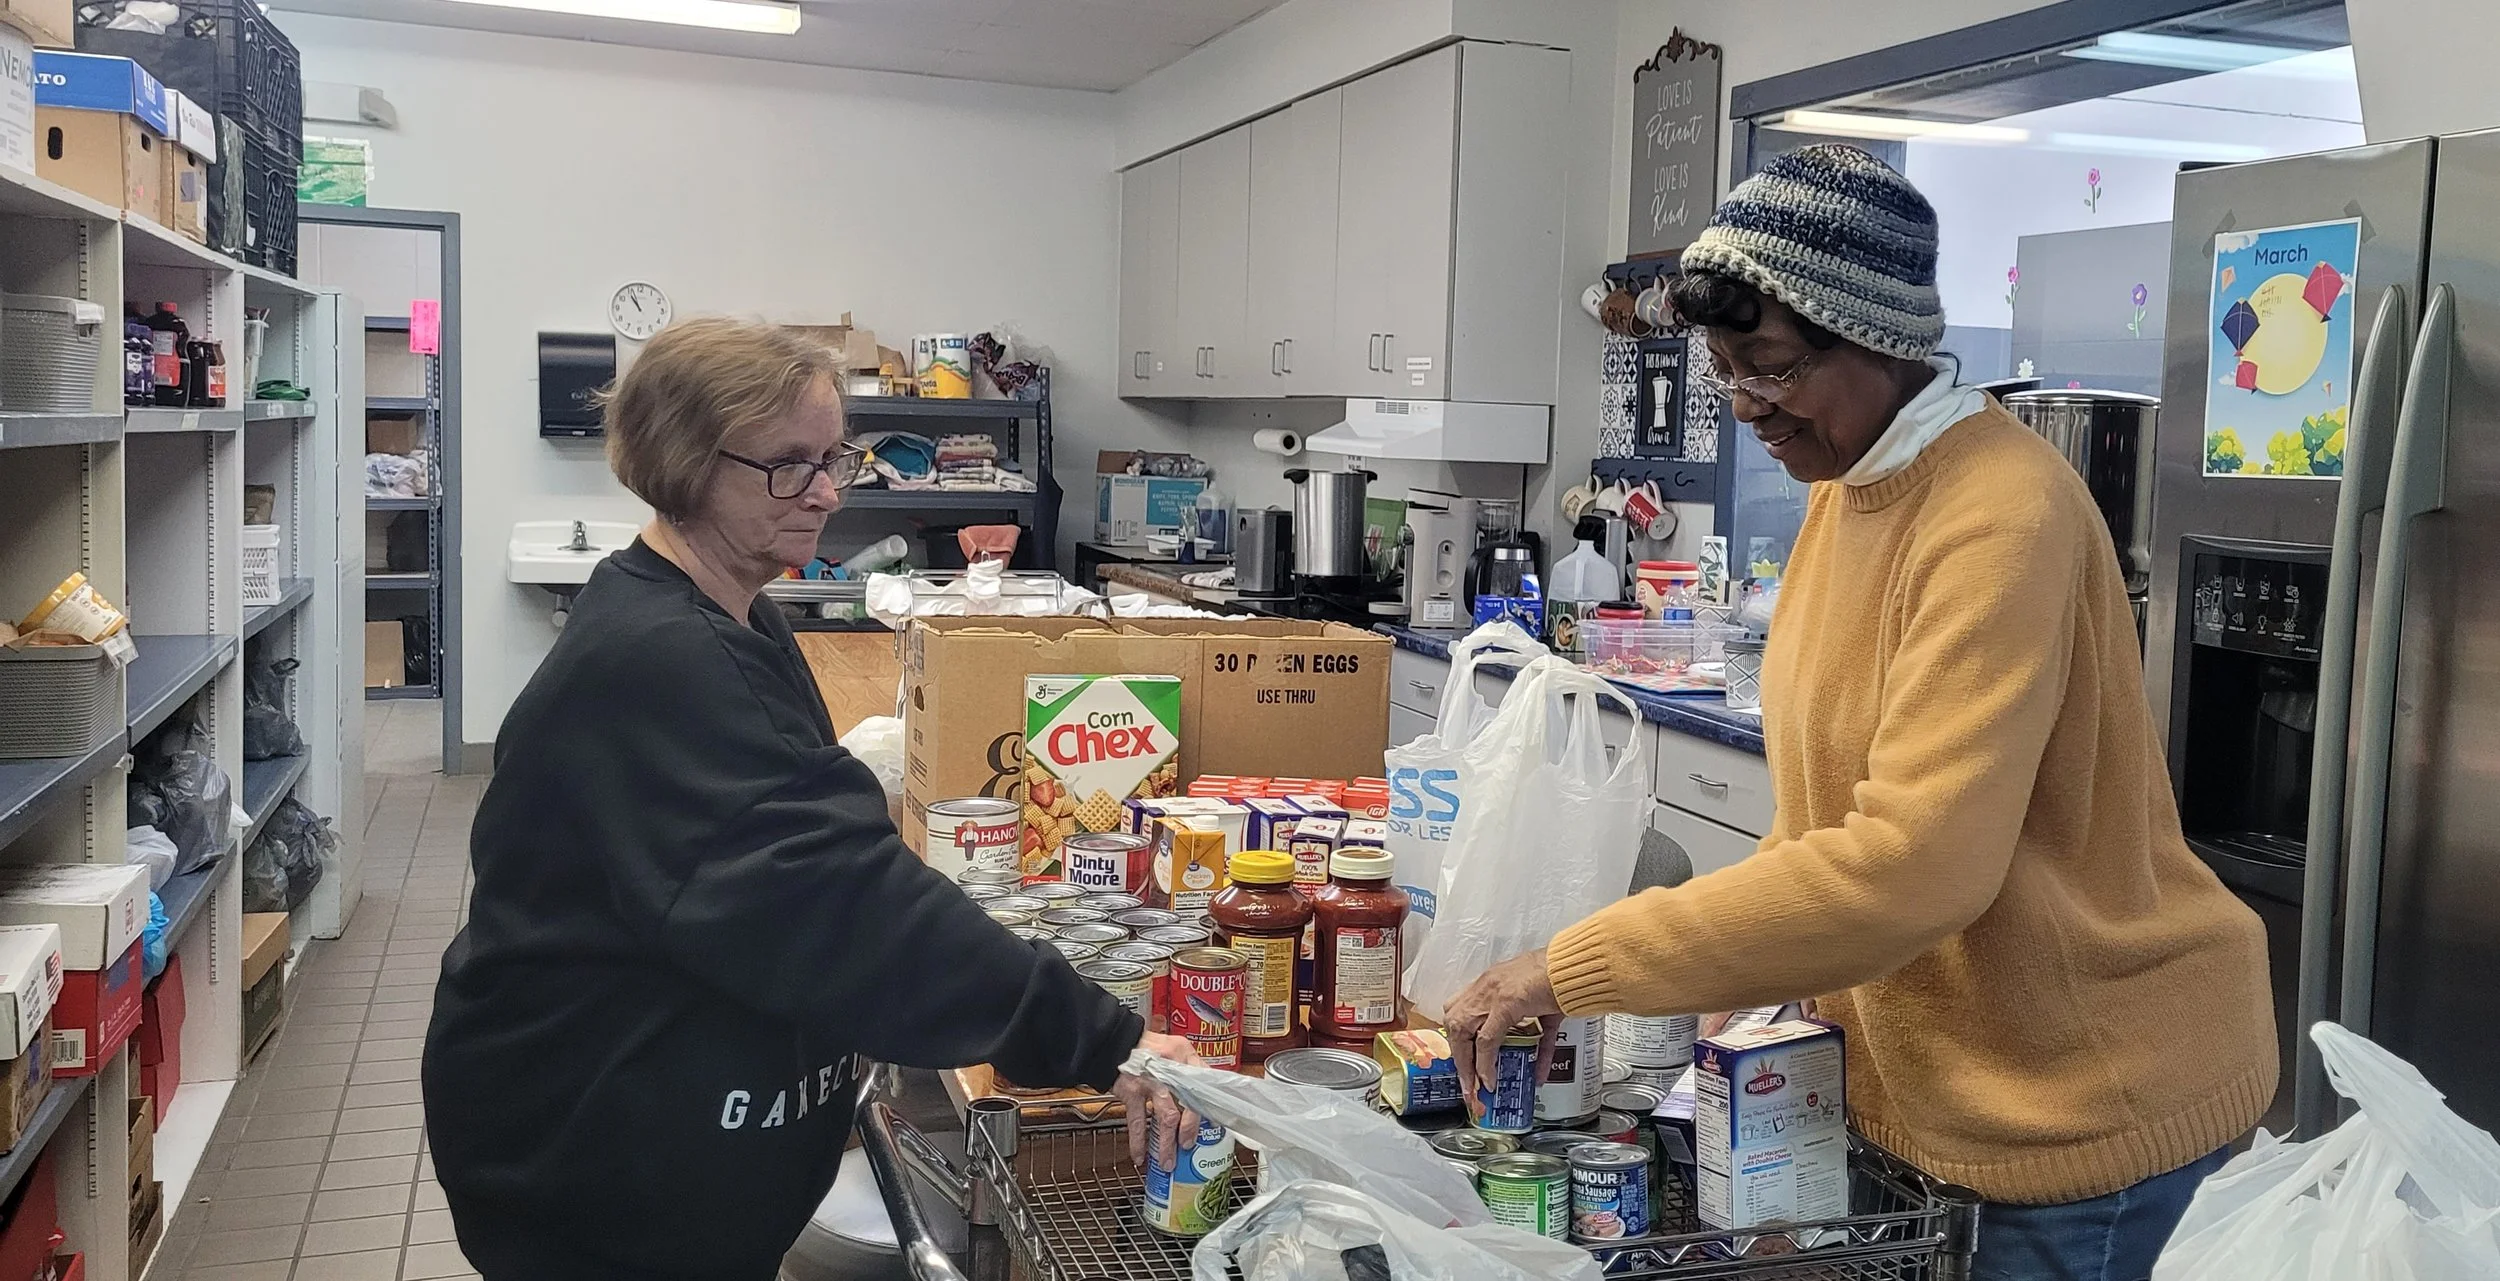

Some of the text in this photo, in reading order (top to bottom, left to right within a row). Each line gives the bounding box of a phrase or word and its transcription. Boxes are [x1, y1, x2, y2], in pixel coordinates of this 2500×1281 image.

[1657, 79, 1693, 111] LOVE IS
[1645, 114, 1703, 159] Patient
[1653, 162, 1690, 191] LOVE IS
[1650, 193, 1690, 238] Kind
[2255, 244, 2308, 266] March
[1214, 653, 1238, 672] 30
[1312, 654, 1359, 674] EGGS
[1257, 689, 1316, 704] USE THRU
[1087, 711, 1134, 729] Corn
[1047, 723, 1159, 767] Chex
[1386, 768, 1460, 823] SS
[1367, 805, 1387, 817] IGA
[1418, 823, 1452, 842] LES
[1072, 853, 1115, 873] Dinty
[1069, 867, 1120, 886] Moore
[1404, 889, 1435, 913] ores
[1257, 961, 1264, 969] 70
[1180, 973, 1235, 992] DOUBLE
[1200, 1020, 1230, 1036] PINK
[1195, 1039, 1238, 1057] ALMON
[1551, 1060, 1571, 1071] eef
[1747, 1075, 1783, 1093] MUELLER'S
[1718, 1100, 1729, 1109] 200
[1197, 1126, 1222, 1137] Great
[1747, 1146, 1788, 1160] Baked Macaroni
[1755, 1156, 1774, 1166] Double
[1774, 1152, 1792, 1160] Cheese
[1198, 1157, 1226, 1169] Green
[1573, 1167, 1619, 1185] RMOUR
[1585, 1184, 1617, 1202] Sausage
